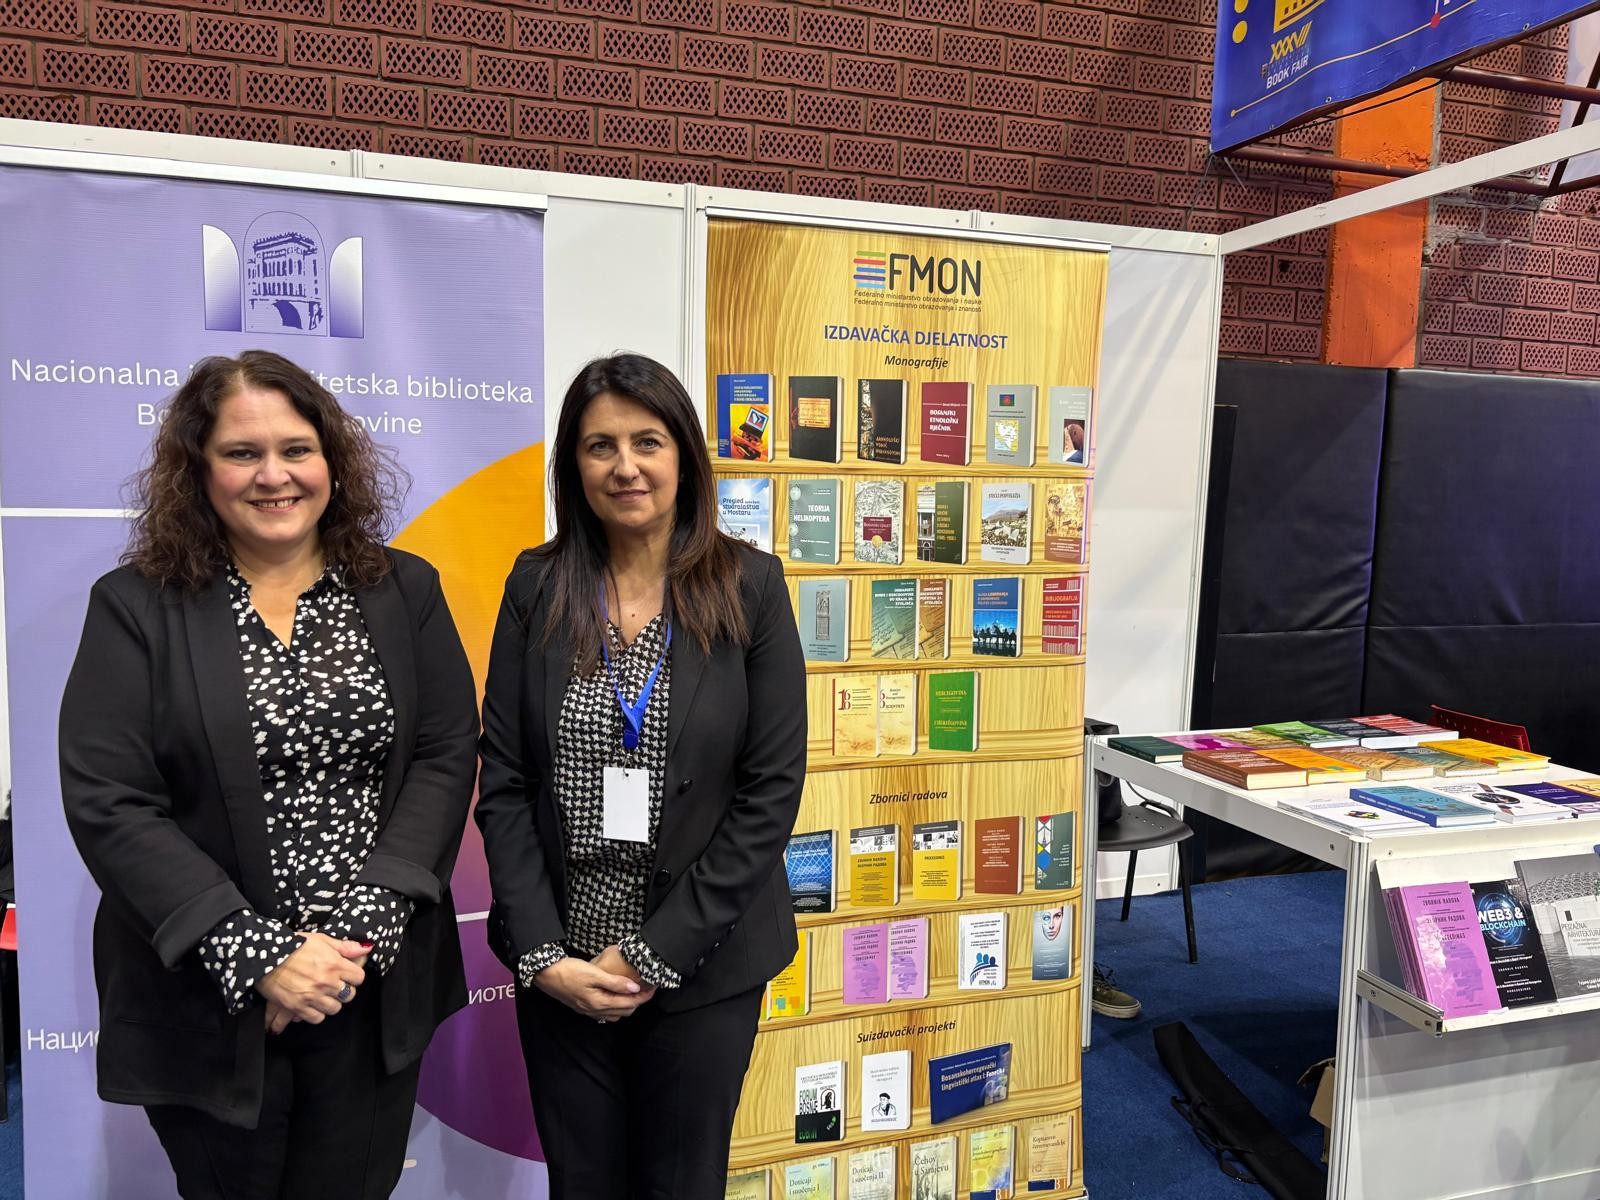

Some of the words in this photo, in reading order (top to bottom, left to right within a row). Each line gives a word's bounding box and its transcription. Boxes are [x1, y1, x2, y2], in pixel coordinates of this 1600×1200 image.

[1266, 66, 1291, 89] BOOK
[1291, 54, 1309, 74] FAIR
[854, 290, 885, 299] Federalno
[885, 293, 921, 302] ministarstvo
[922, 296, 959, 305] obrazovanja
[854, 298, 884, 307] Federalno
[884, 301, 918, 309] ministarstvo
[918, 303, 954, 312] obrazovanja
[958, 305, 982, 313] znanosti
[824, 324, 910, 345] IZDAVAČKA
[915, 331, 1008, 349] DJELATNOST
[884, 354, 949, 371] Monografije
[10, 358, 180, 387] Nacionalna
[406, 374, 533, 404] biblioteka
[722, 497, 744, 505] Pregled
[807, 504, 831, 512] TEORIJA
[793, 514, 831, 523] HELIKOPTERA
[869, 792, 910, 804] Zbornici
[912, 790, 948, 800] radova
[1478, 908, 1512, 923] WEB3
[1514, 906, 1524, 919] &
[1480, 919, 1526, 931] BLOCKCHAIN
[857, 1024, 915, 1043] Suizdavački
[917, 1020, 956, 1036] projekti
[914, 1153, 937, 1165] Čehov
[920, 1163, 949, 1176] Sarajevu
